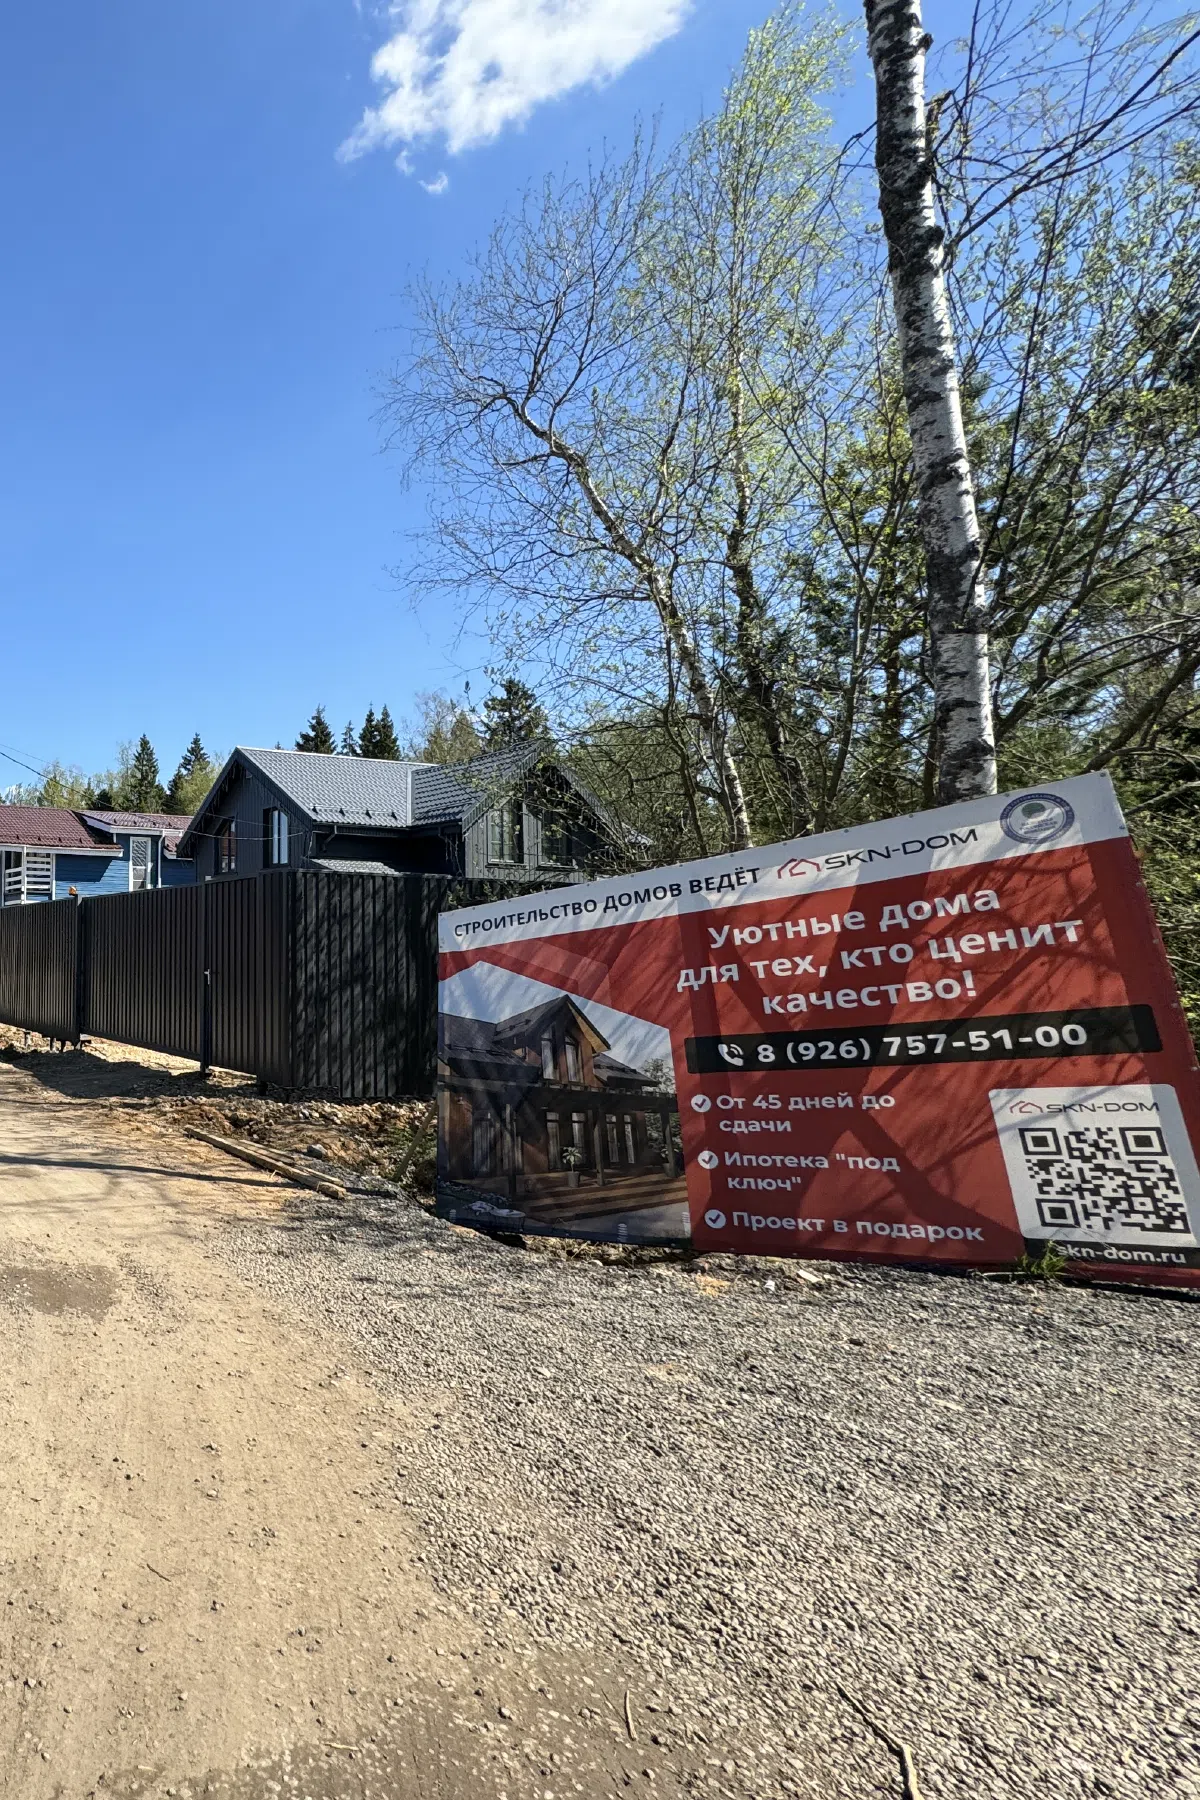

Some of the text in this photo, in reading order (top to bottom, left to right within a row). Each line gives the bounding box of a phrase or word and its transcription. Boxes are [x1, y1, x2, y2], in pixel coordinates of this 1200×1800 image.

[825, 828, 978, 870] SKN-DOM
[454, 867, 760, 937] СТРОИТЕЛЬСТВО ДОМОВ ВЕДЁТ
[707, 889, 1000, 949] Уютные дома
[676, 919, 1084, 992] для тех, кто ценит
[762, 971, 976, 1015] качество!
[757, 1024, 1088, 1064] 8 (926) 757-51-00
[716, 1092, 896, 1110] От 45 дней до
[1046, 1102, 1160, 1113] SKN-DOM
[719, 1119, 792, 1134] сдачи
[724, 1151, 901, 1173] Ипотека "под
[727, 1177, 802, 1192] ключ"
[732, 1211, 985, 1243] Проект в подарок
[1057, 1244, 1186, 1264] skn-dom.ru
